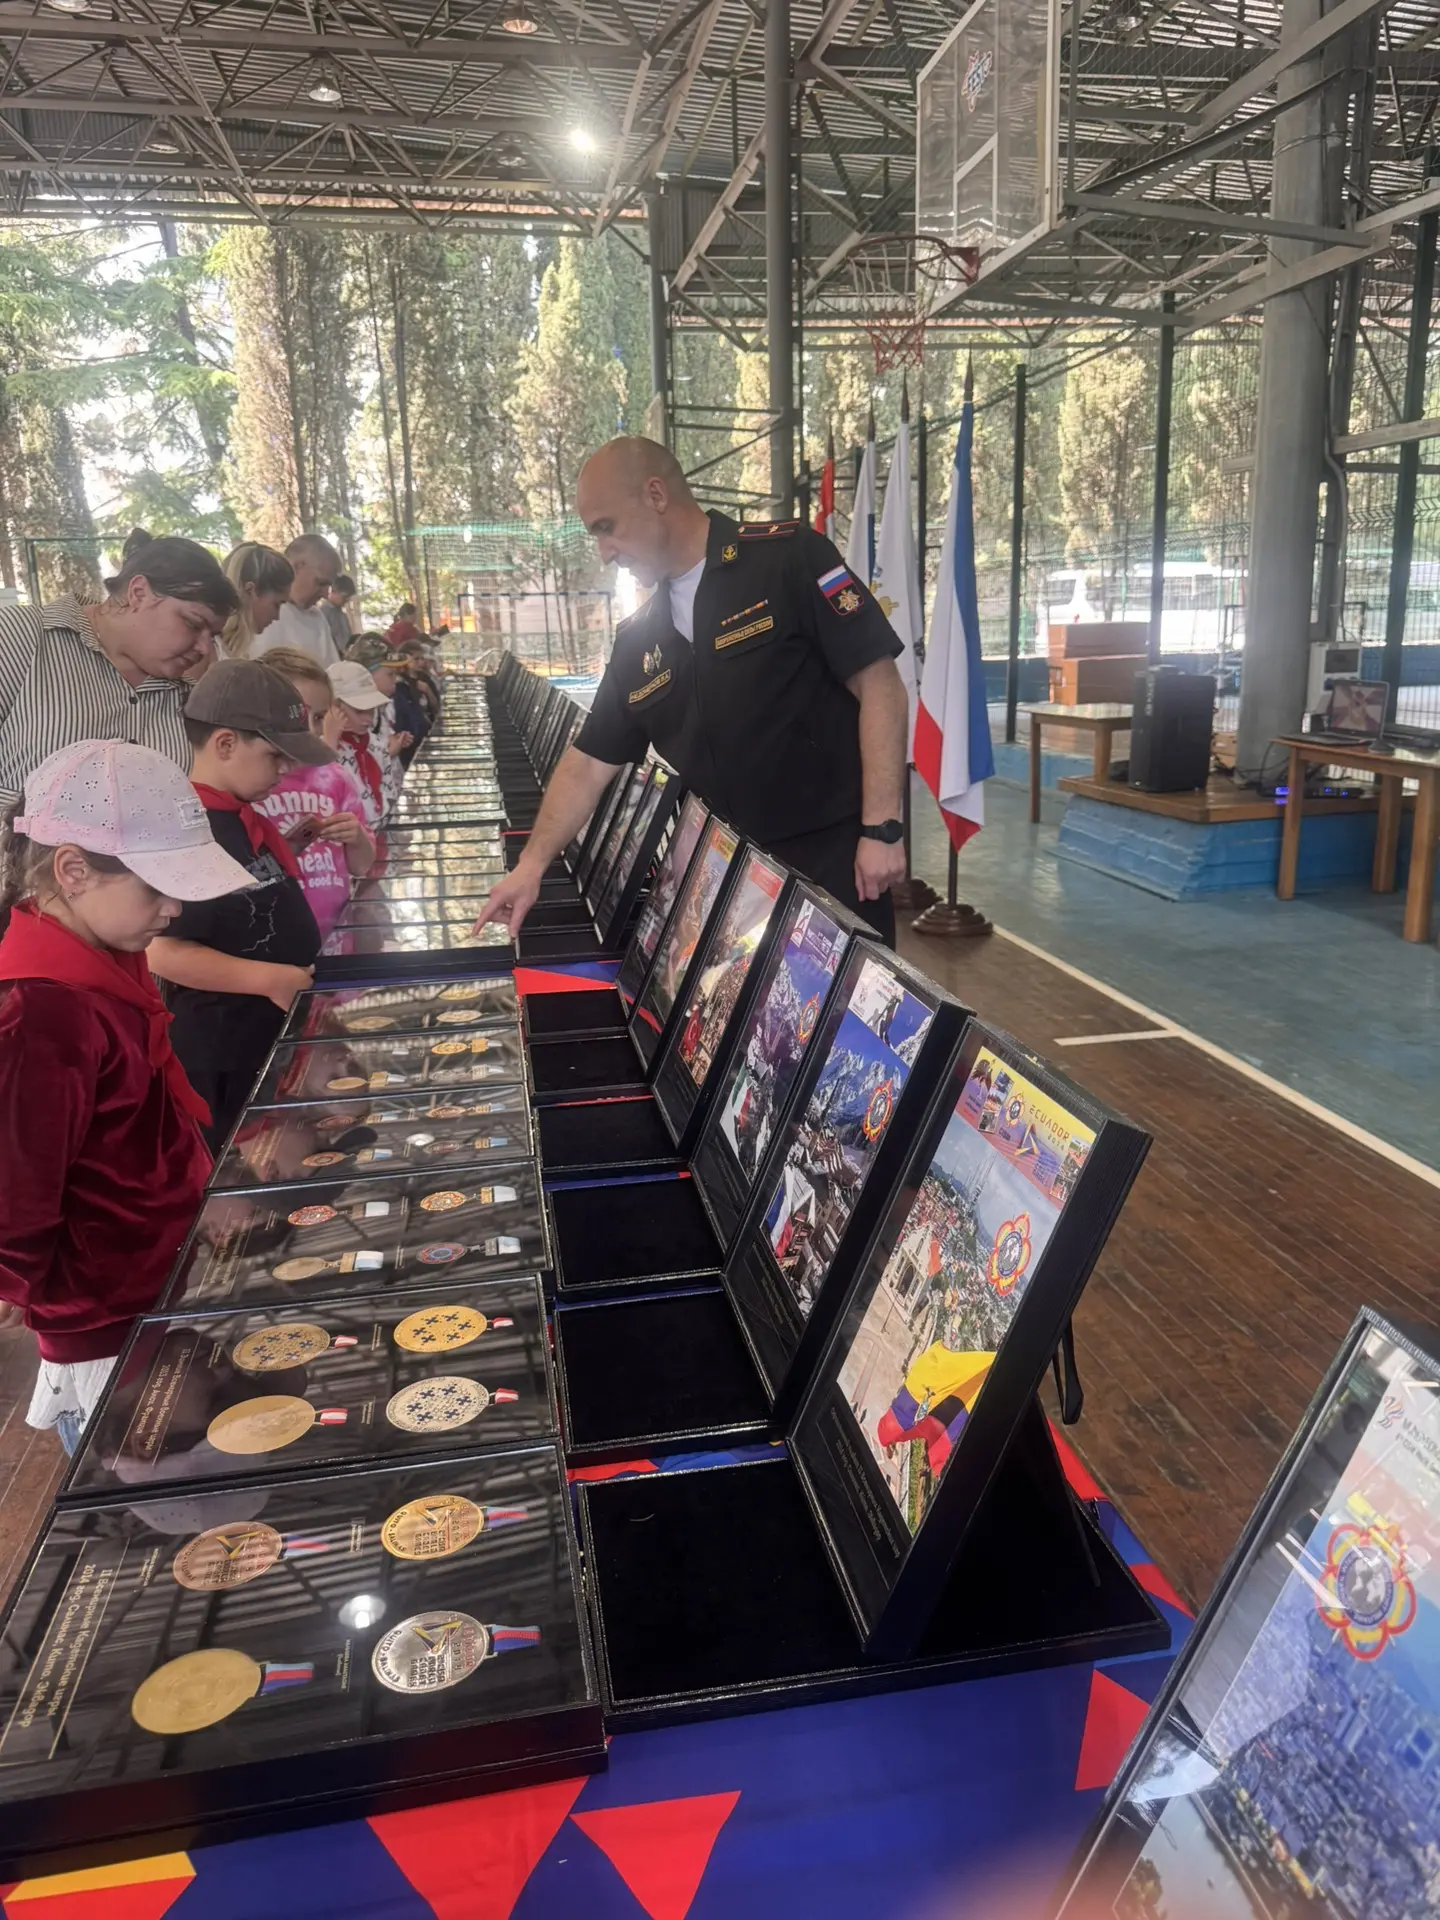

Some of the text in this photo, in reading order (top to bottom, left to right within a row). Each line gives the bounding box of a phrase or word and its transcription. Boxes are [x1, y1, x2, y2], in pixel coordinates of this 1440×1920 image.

[1029, 1104, 1070, 1142] ECUADOR
[81, 1562, 97, 1584] 2014
[47, 1567, 113, 1717] II Всемирные Кадетские игры
[380, 1630, 402, 1683] QUITO SALINAS
[453, 1642, 462, 1671] 2014
[18, 1680, 50, 1728] Эквадор
